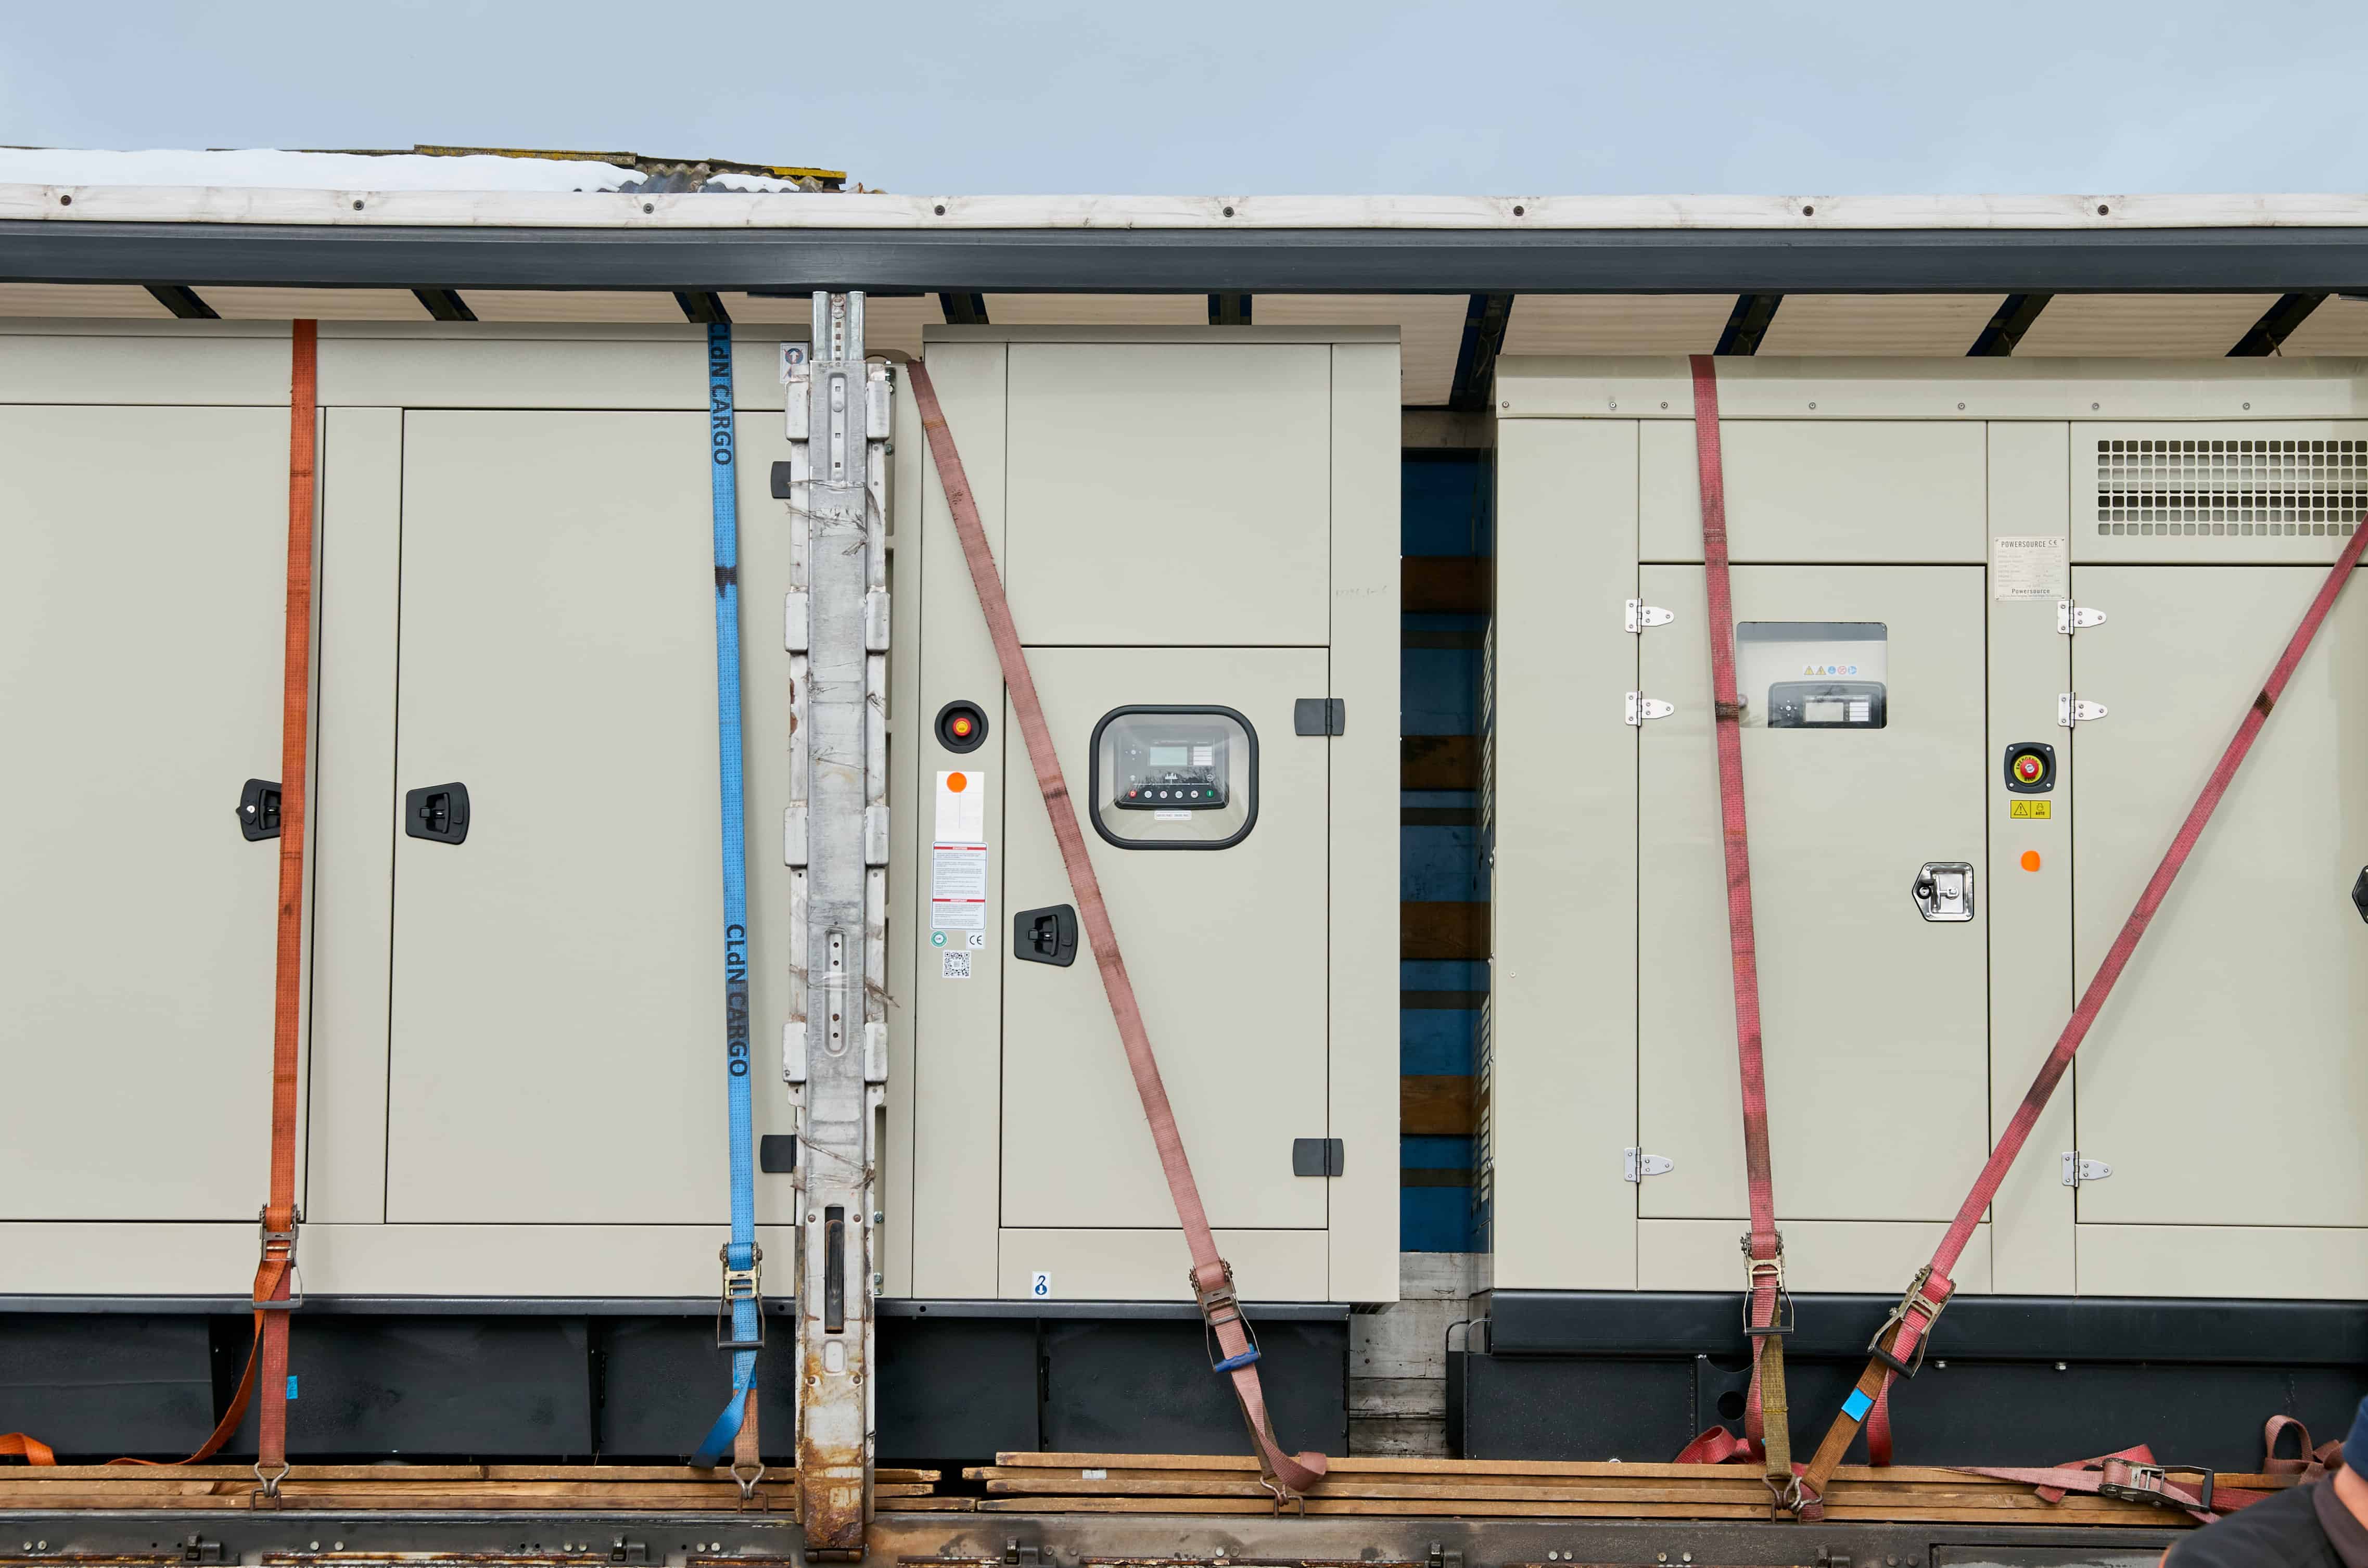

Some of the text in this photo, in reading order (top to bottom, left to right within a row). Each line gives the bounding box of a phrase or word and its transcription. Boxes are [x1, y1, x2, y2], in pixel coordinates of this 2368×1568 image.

[712, 385, 732, 465] CARGO
[970, 935, 983, 945] CE
[727, 924, 748, 1077] CLdN CARGO
